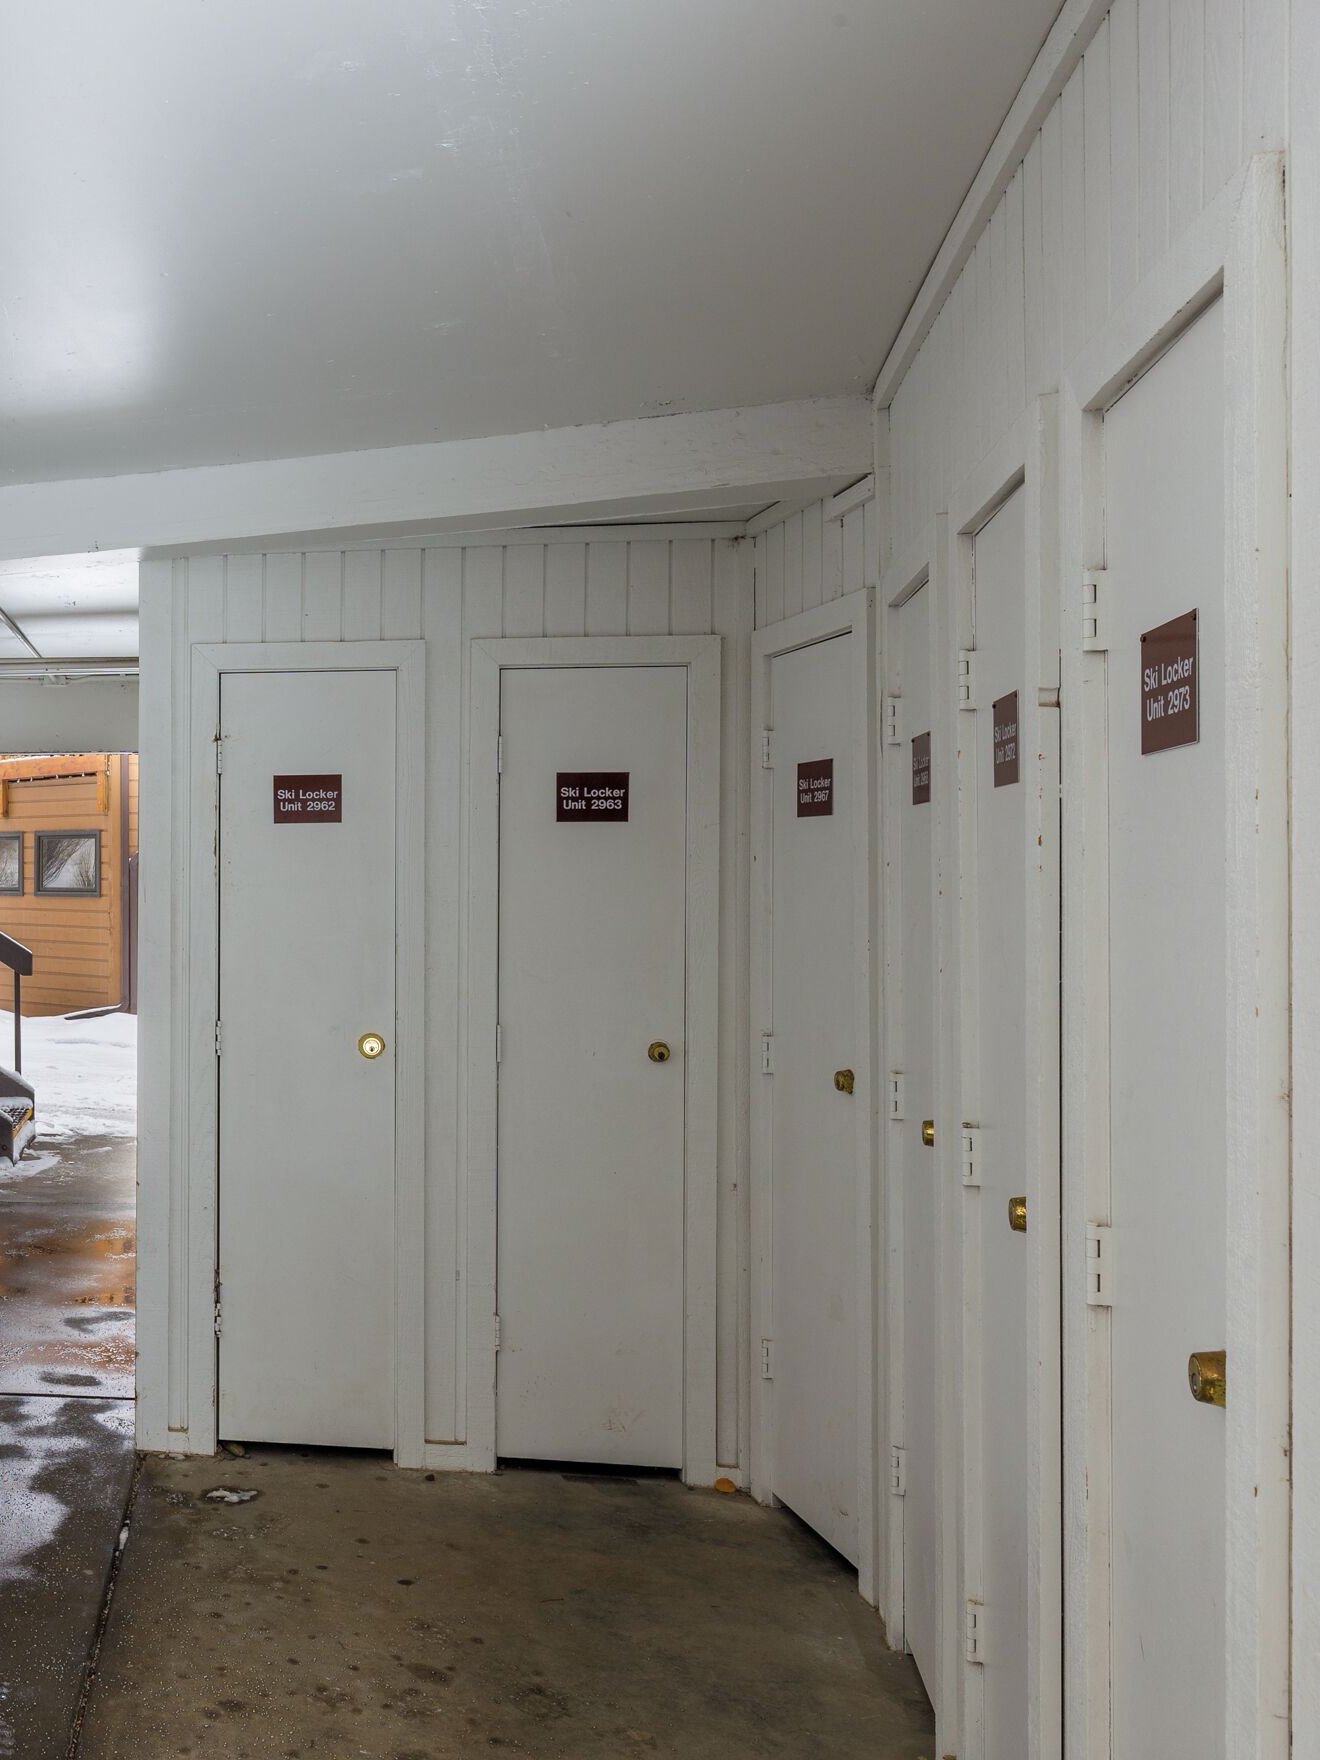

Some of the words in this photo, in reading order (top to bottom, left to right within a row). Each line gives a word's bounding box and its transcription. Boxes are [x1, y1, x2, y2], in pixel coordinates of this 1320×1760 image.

[1144, 668, 1159, 692] Ski
[1161, 656, 1194, 686] Locker
[1146, 696, 1165, 721] Unit
[1167, 685, 1191, 715] 2973
[1002, 721, 1016, 740] Locker
[996, 747, 1004, 764] Unit
[1005, 742, 1016, 761] 2972
[799, 779, 808, 790] Ski
[810, 777, 830, 788] Locker
[278, 790, 294, 799] Ski
[300, 789, 338, 798] Locker
[560, 787, 580, 797] Ski
[584, 787, 626, 797] Locker
[800, 792, 812, 804] Unit
[814, 790, 829, 802] 2967
[280, 802, 302, 811] Unit
[306, 801, 336, 810] 2962
[563, 800, 586, 810] Unit
[591, 800, 622, 810] 2963
